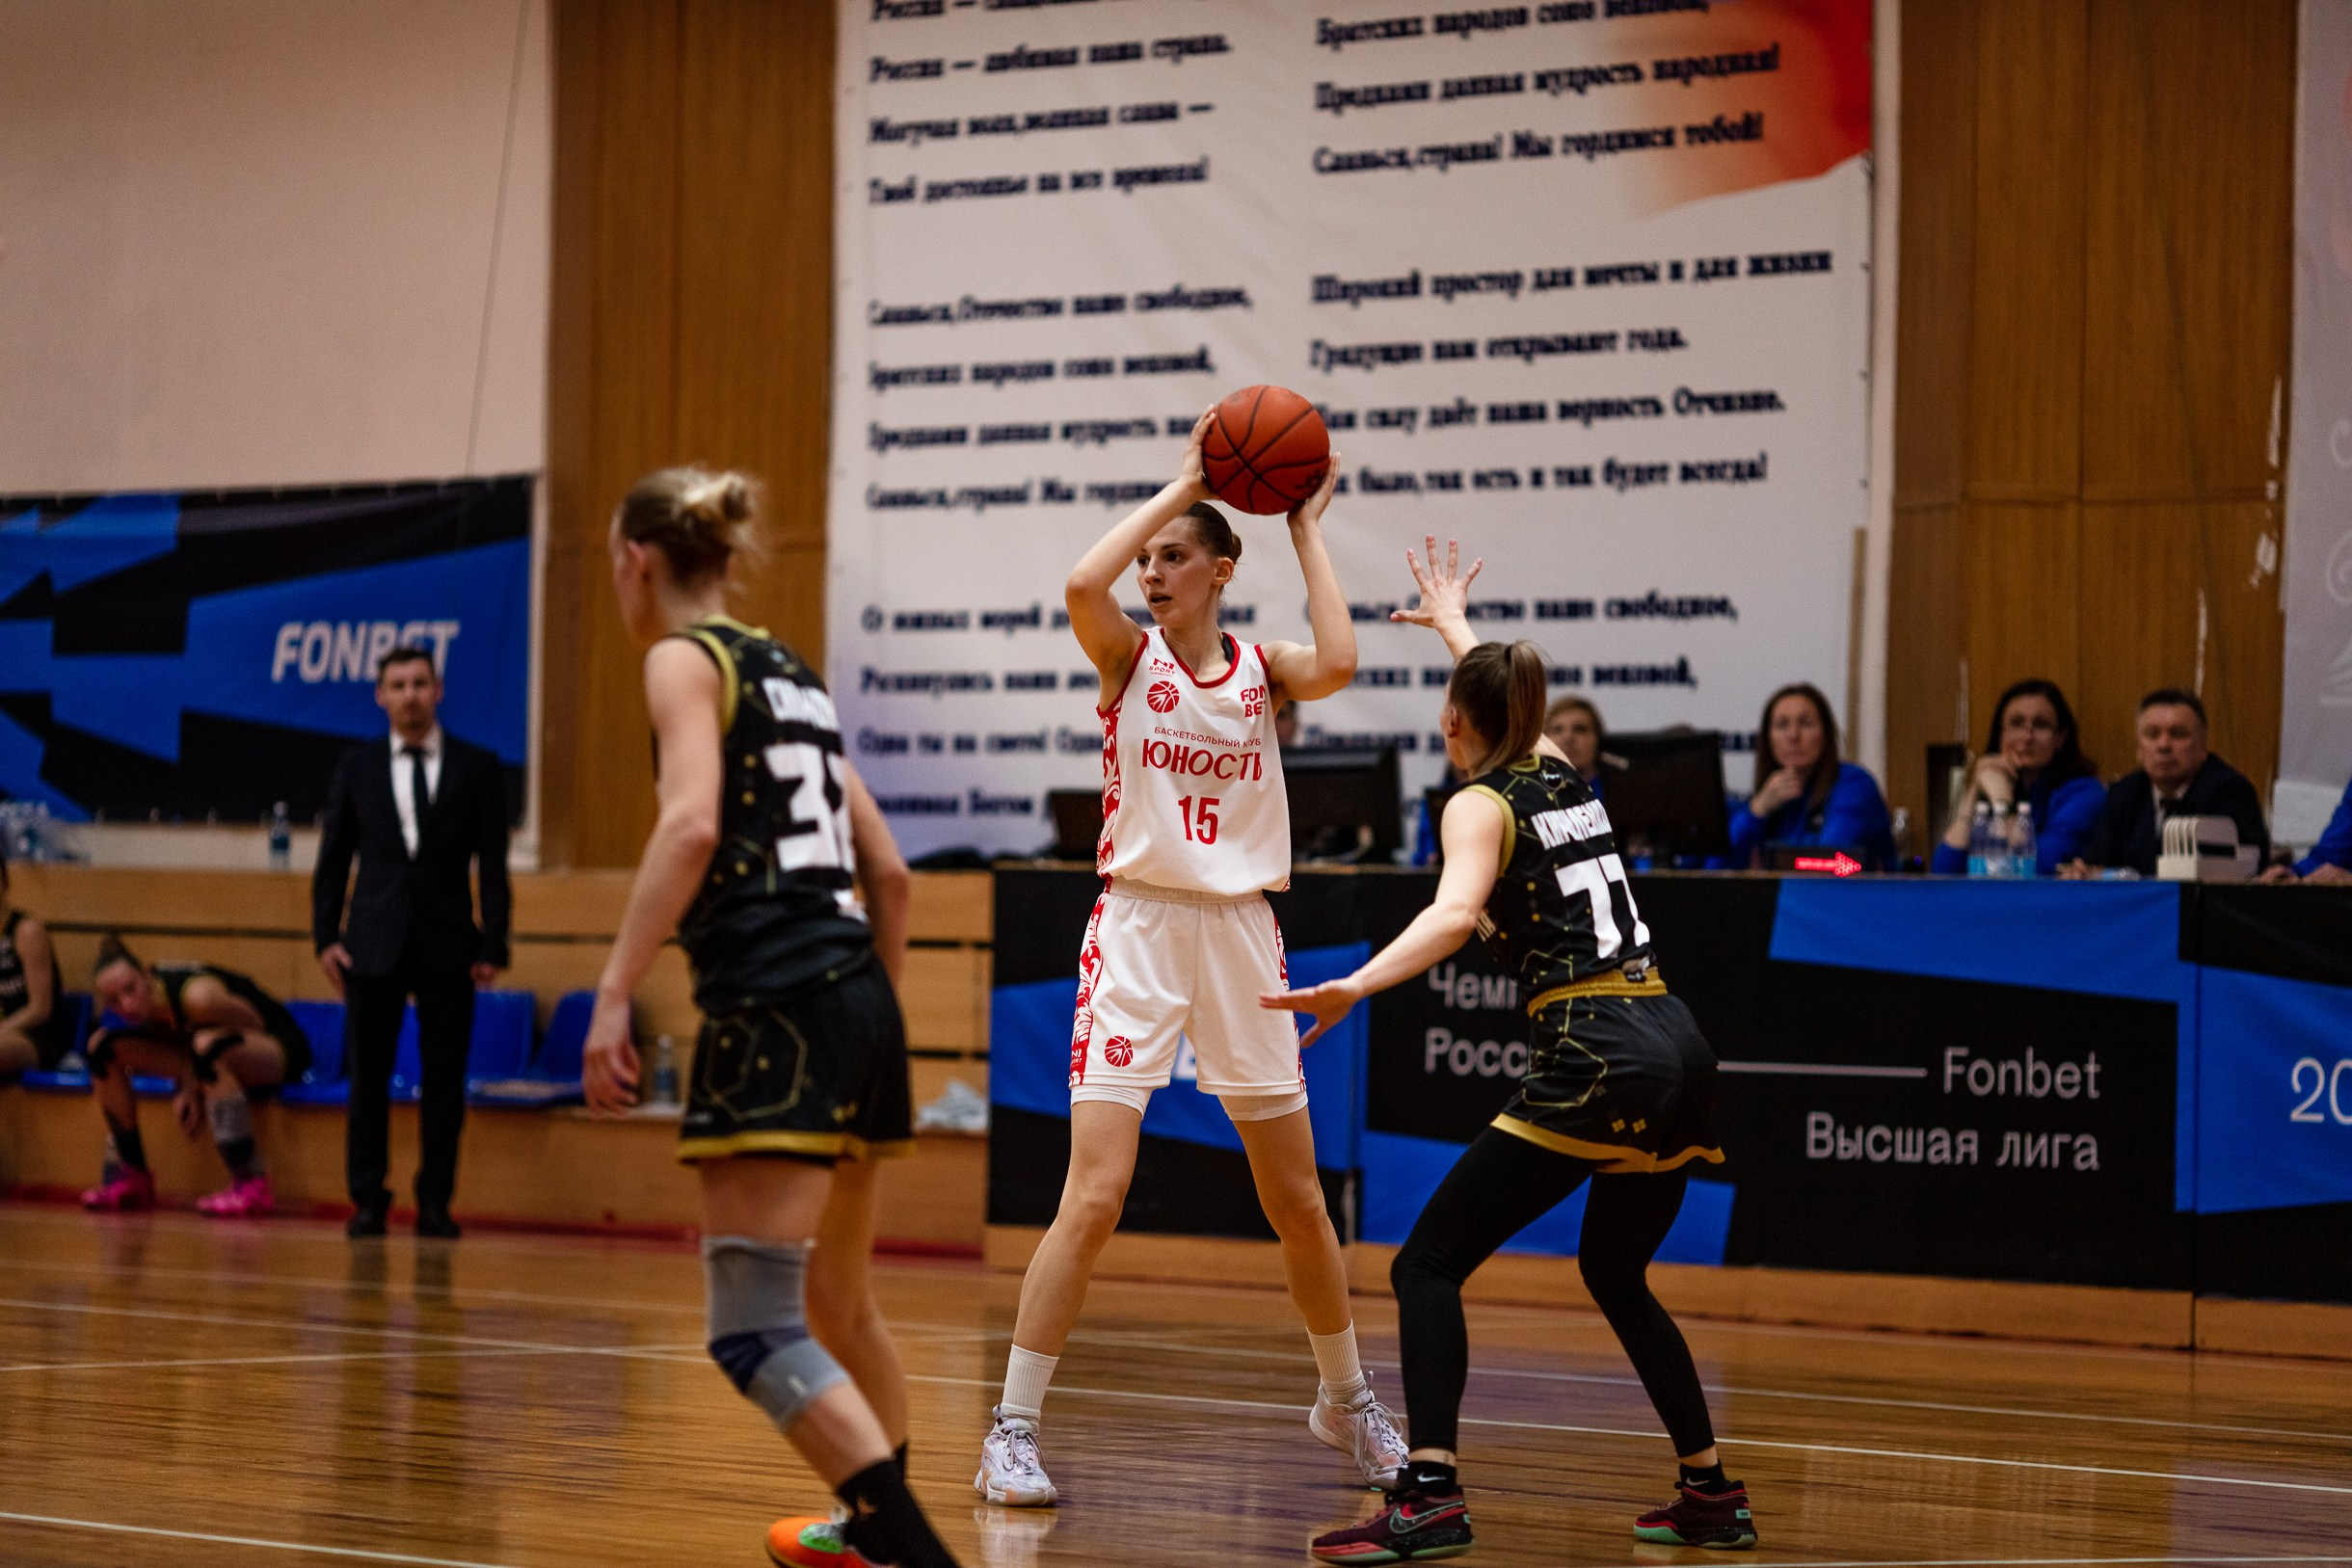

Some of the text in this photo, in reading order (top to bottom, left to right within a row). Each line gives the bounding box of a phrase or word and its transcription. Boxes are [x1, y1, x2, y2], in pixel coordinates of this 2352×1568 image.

[1244, 701, 1266, 718] BE
[1142, 738, 1263, 782] ЮНОСТЬ
[1154, 726, 1240, 748] БАСКЕТБОЛЬНЫЙ
[1178, 795, 1220, 845] 15
[1425, 1026, 1529, 1078] Росс
[1942, 1047, 2102, 1100] Fonbet
[1804, 1110, 2101, 1172] Высшая лига
